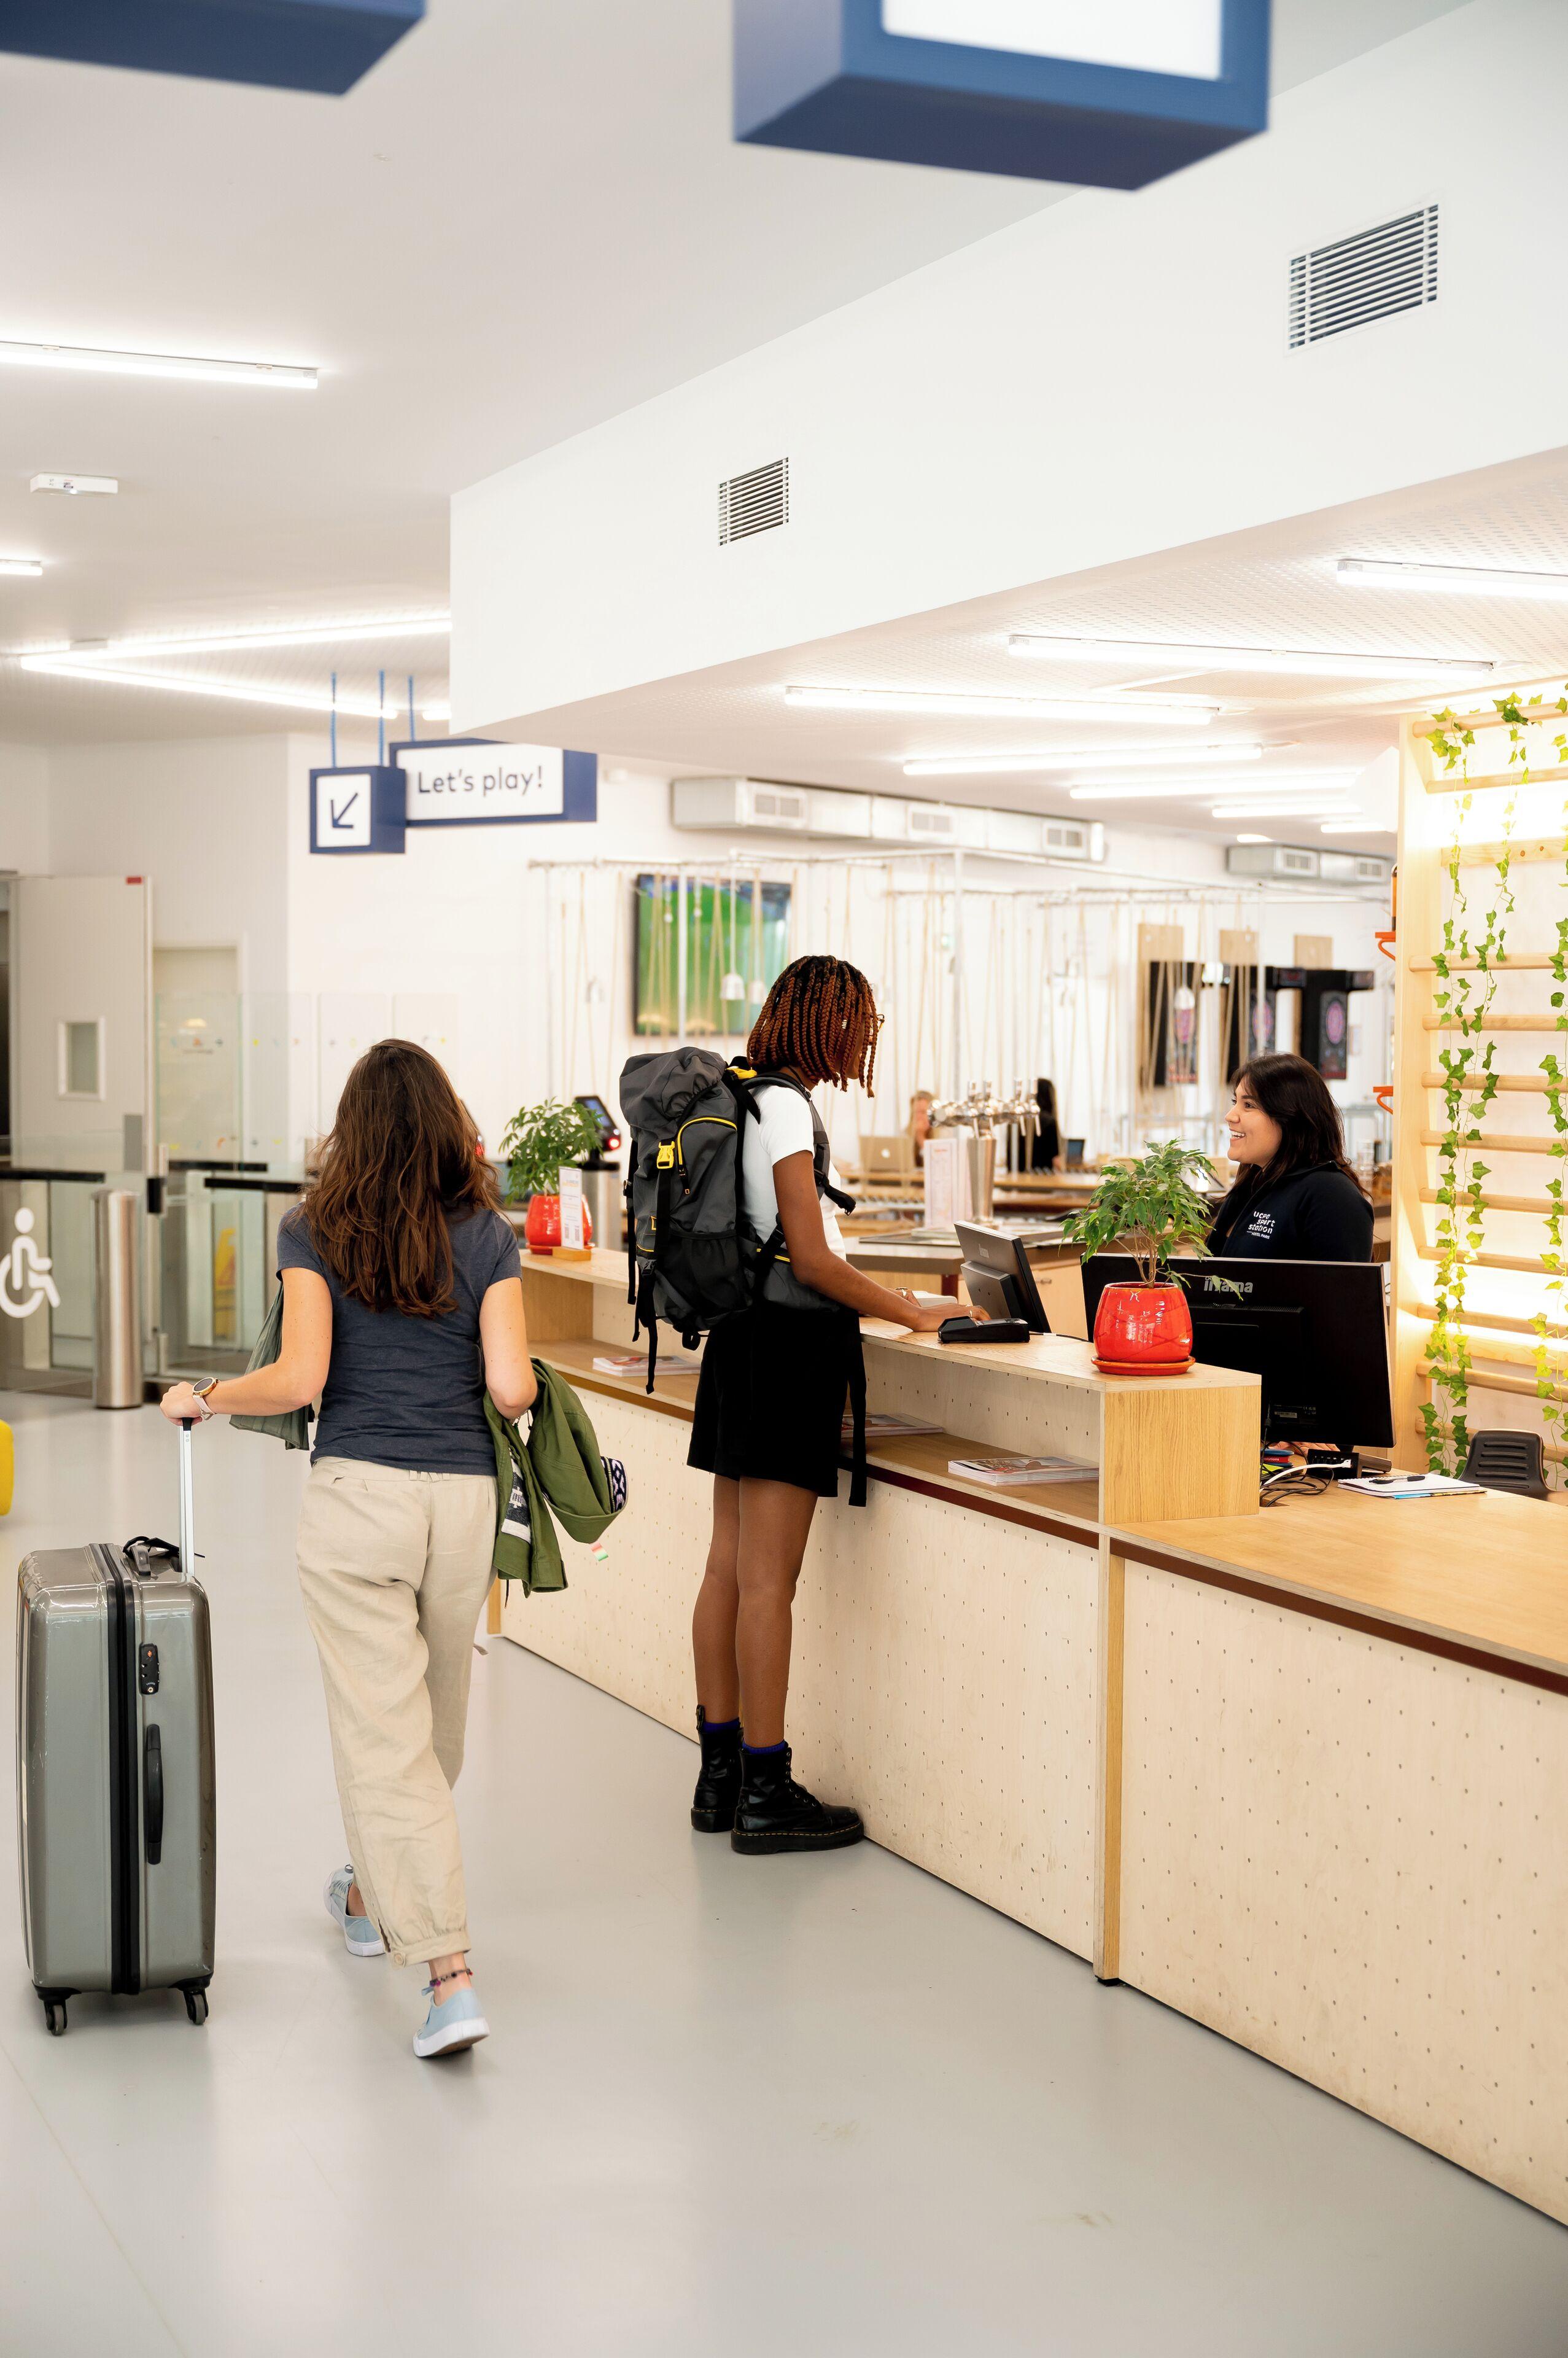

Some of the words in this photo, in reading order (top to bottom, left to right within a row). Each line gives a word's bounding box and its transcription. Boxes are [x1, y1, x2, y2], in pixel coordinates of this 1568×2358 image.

[418, 768, 474, 793] Let's
[483, 766, 542, 797] play!
[1248, 1224, 1273, 1234] station
[1204, 1277, 1254, 1293] iiama
